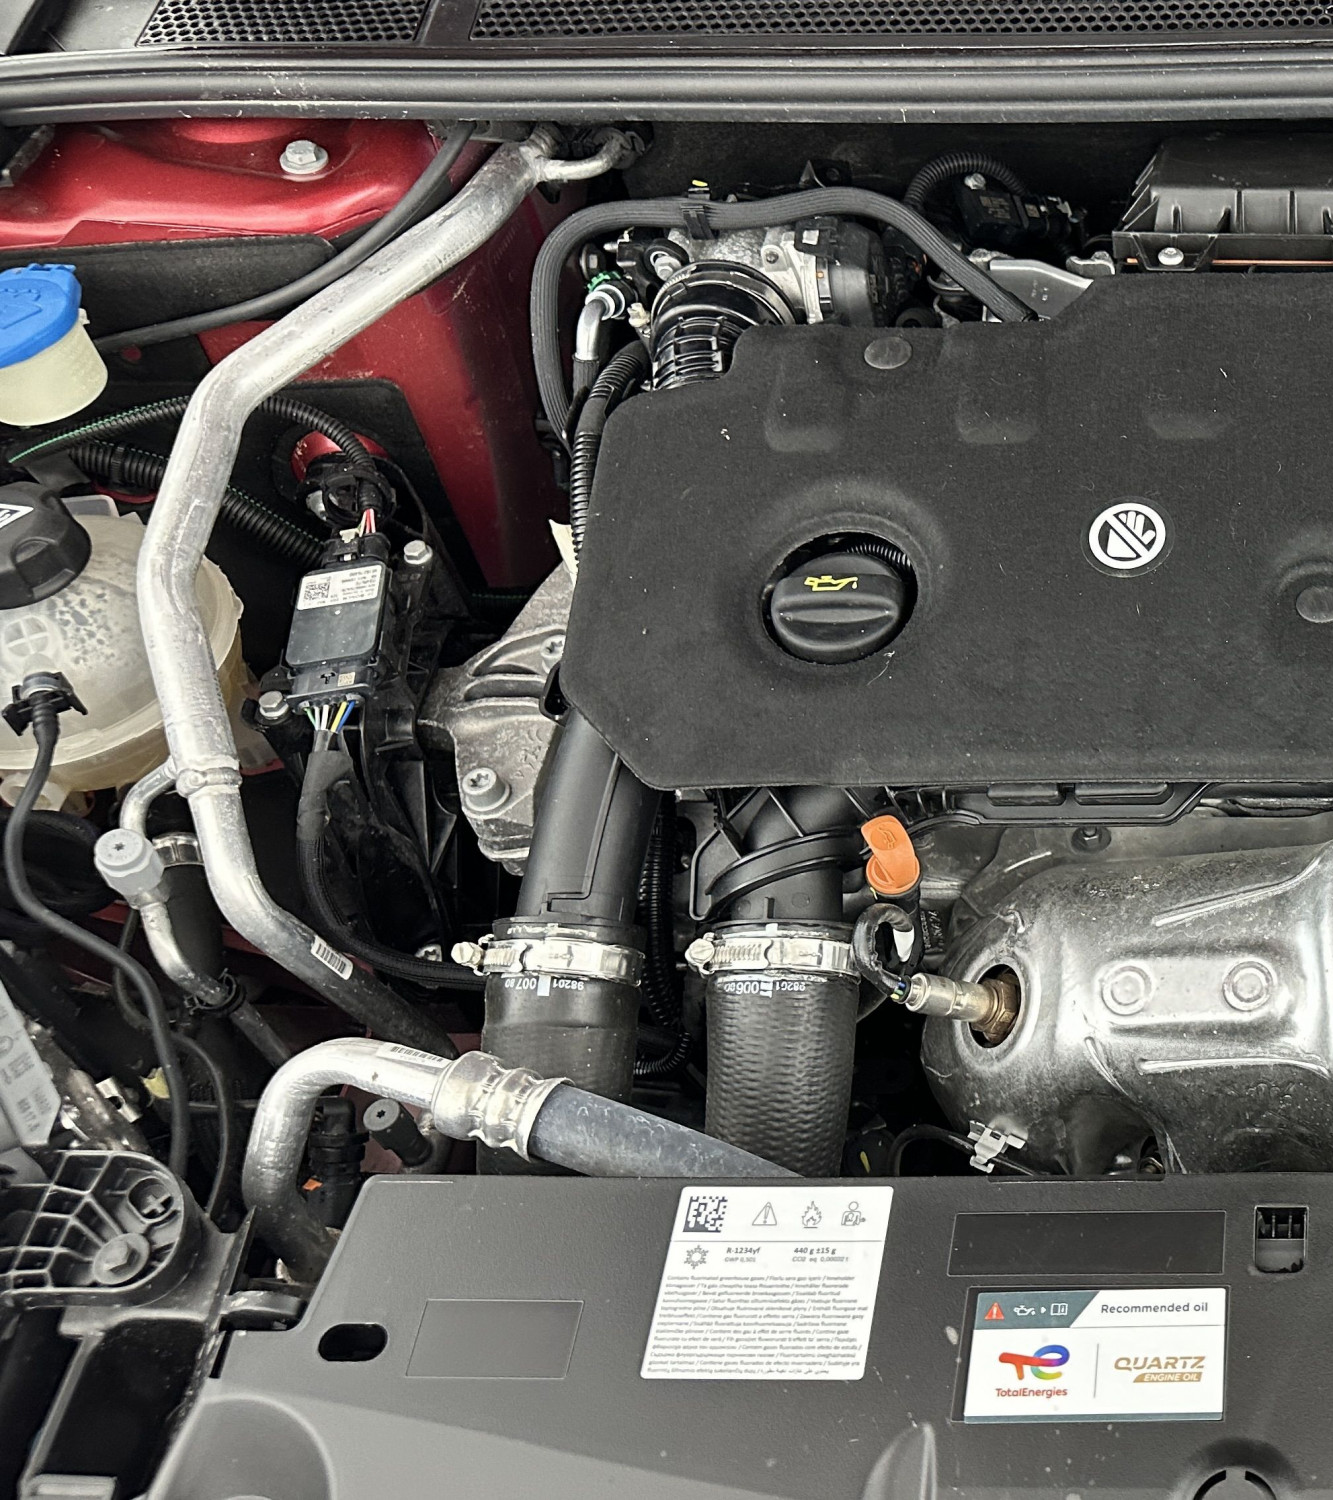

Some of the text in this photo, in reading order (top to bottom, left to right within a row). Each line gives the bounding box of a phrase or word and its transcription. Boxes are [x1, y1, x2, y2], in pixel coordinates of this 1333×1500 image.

[552, 979, 584, 990] 98201
[726, 1247, 761, 1255] R-1234yf
[1101, 1302, 1208, 1314] Recommended oil
[1114, 1355, 1206, 1371] QUARTZ
[1143, 1373, 1199, 1382] ENGINE OIL
[995, 1387, 1068, 1399] TotalEnergies
